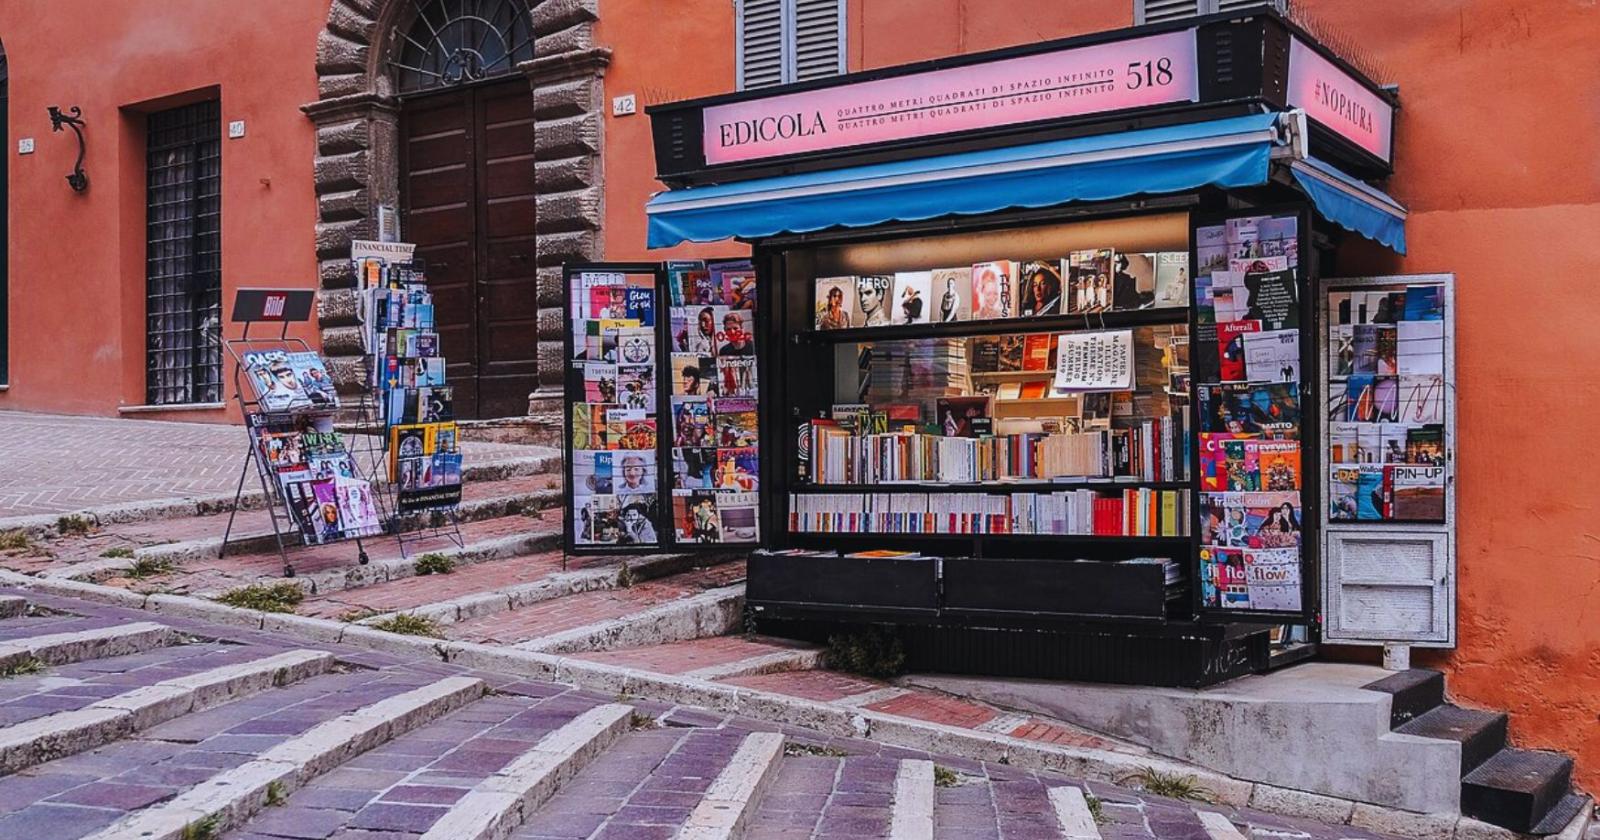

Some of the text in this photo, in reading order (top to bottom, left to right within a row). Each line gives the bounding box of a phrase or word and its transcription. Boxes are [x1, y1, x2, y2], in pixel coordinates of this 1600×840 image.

[1126, 57, 1173, 90] 518
[615, 98, 633, 112] 42
[837, 68, 1114, 117] QUATTRO METRI QUADRATI DI SPAZIO INFINITO
[1315, 78, 1373, 134] #NOPAURA
[838, 83, 1115, 131] QUATTRO METRI QUADRATI DI SPAZIO INFINITO
[719, 111, 827, 148] EDICOLA
[355, 242, 393, 252] FINANCIAL
[858, 277, 890, 290] HERO
[263, 295, 286, 317] Bild
[1224, 323, 1253, 332] Afterall
[1111, 335, 1119, 385] MAGAZINE
[1254, 567, 1287, 580] flow
